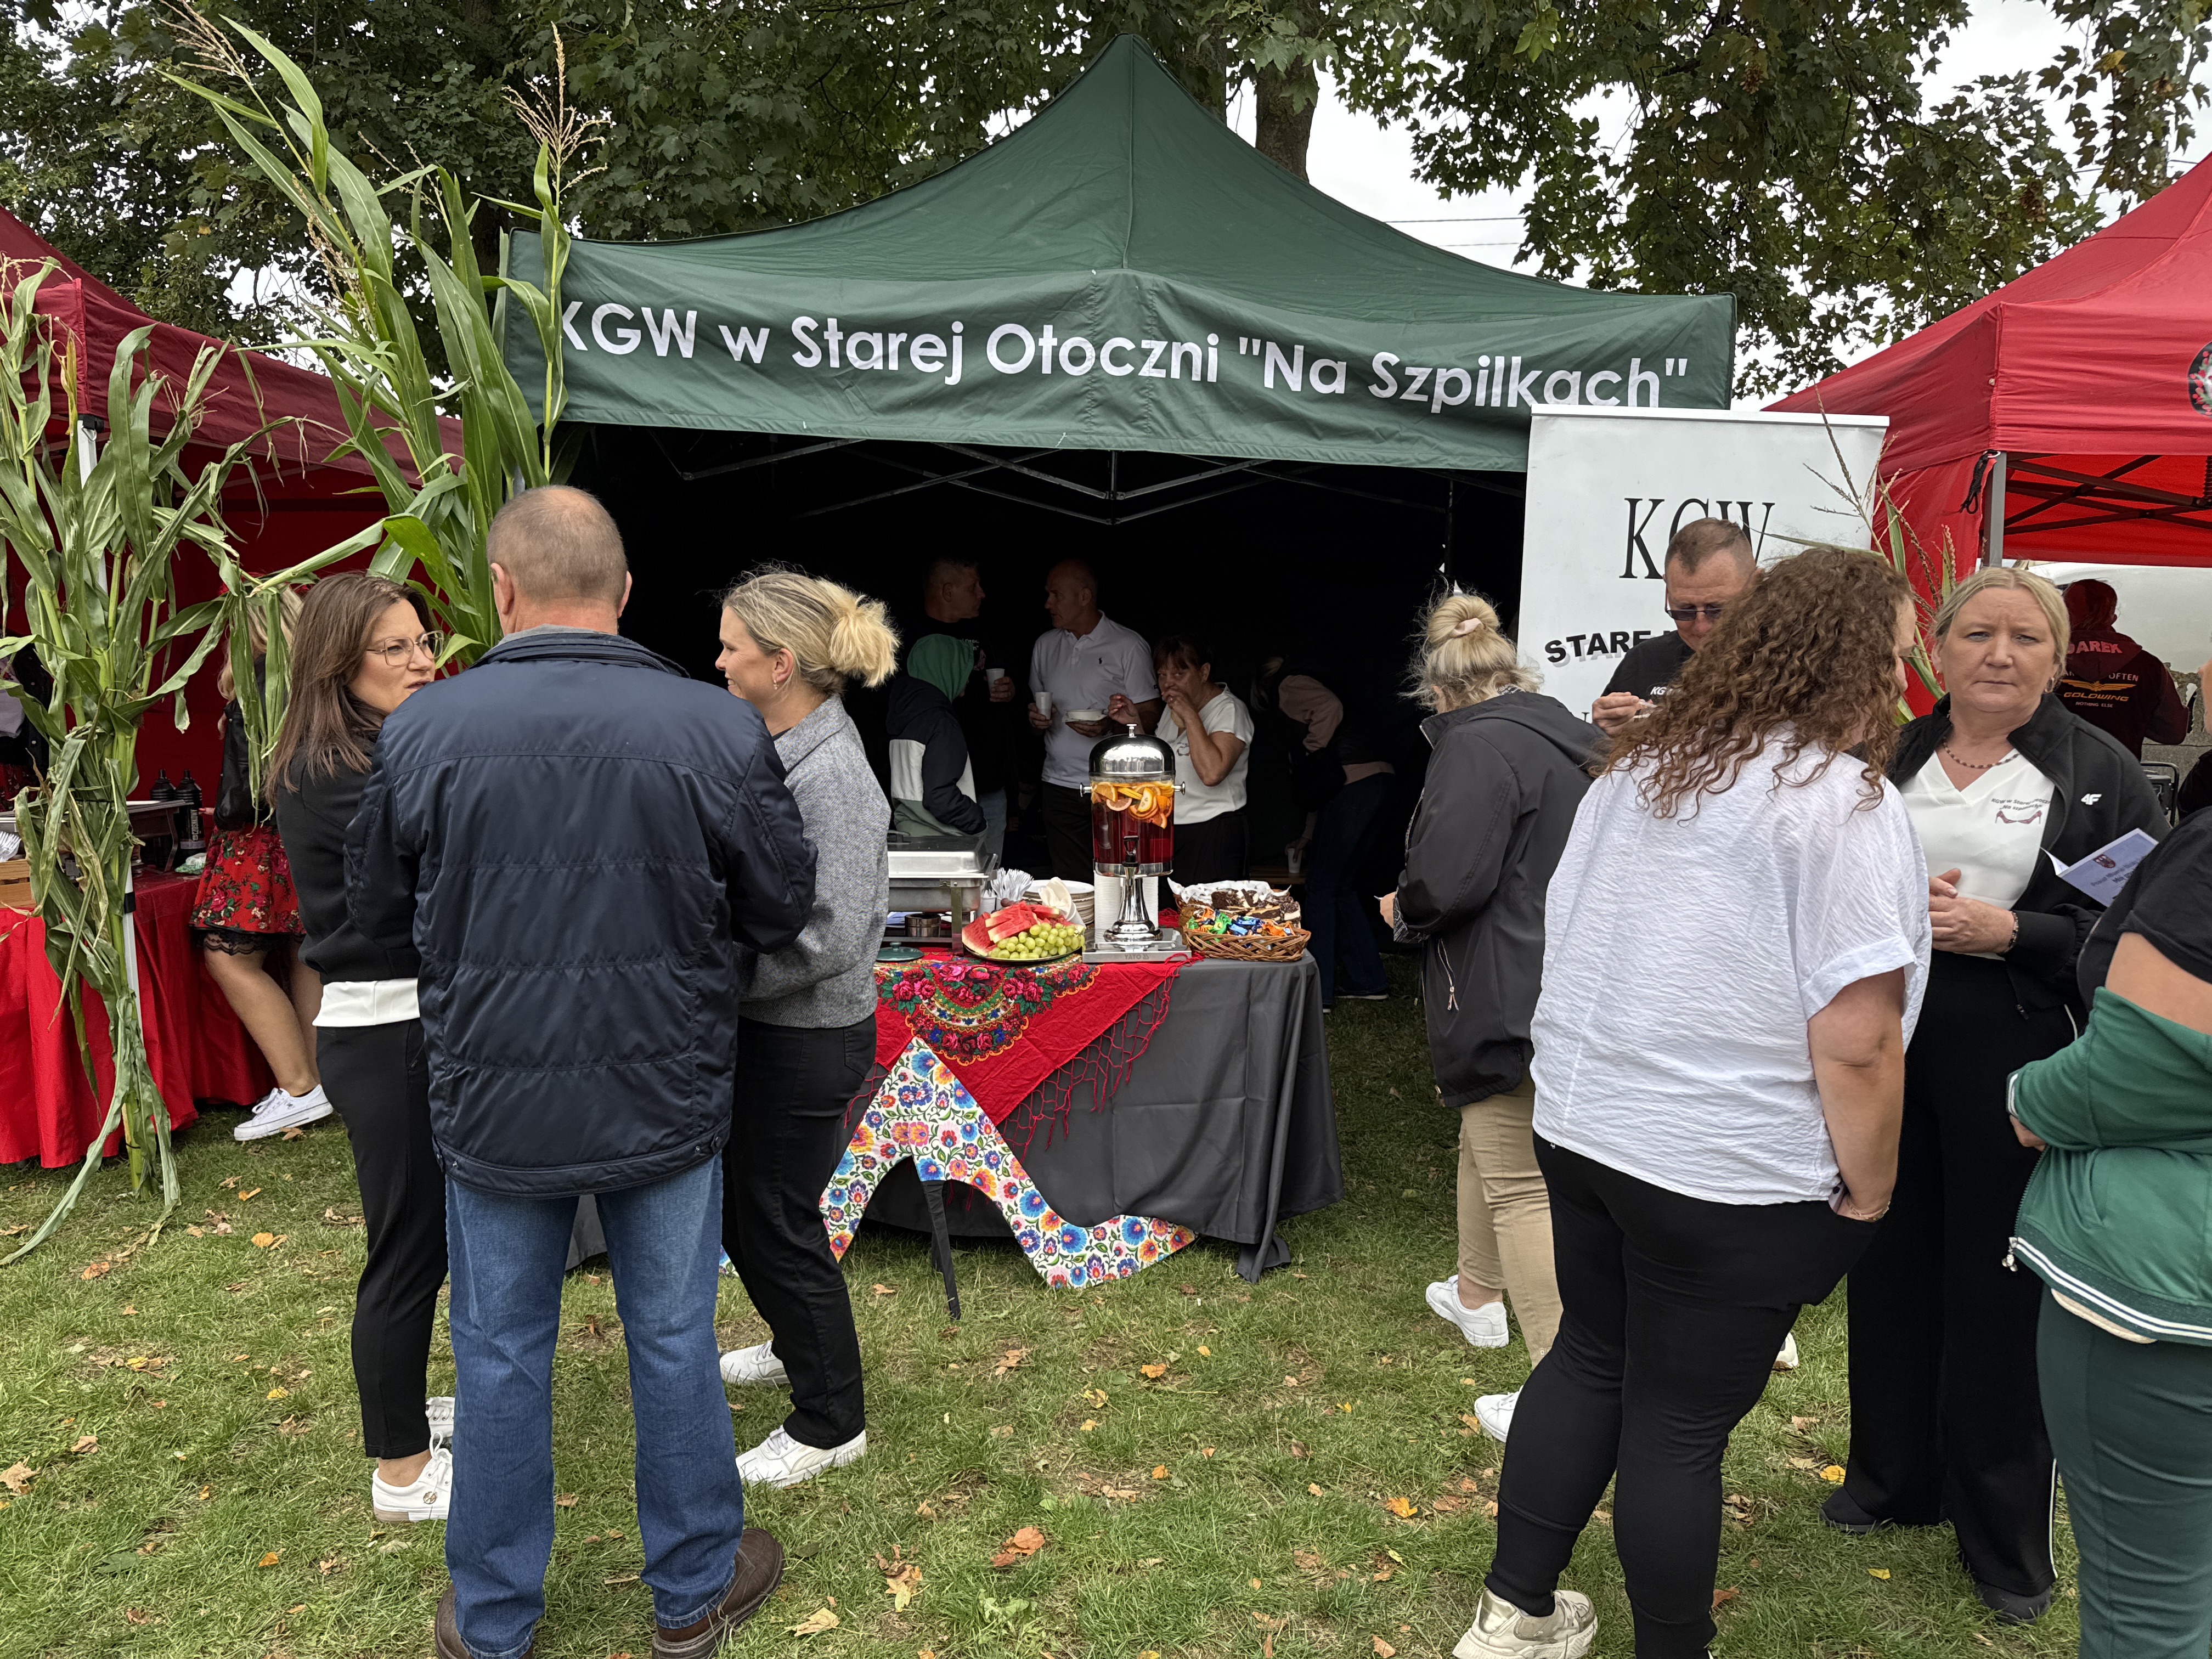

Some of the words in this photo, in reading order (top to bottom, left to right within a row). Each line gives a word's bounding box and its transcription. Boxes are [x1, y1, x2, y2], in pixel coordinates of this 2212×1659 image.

[562, 301, 698, 358] KGW
[718, 324, 770, 364] w
[791, 316, 964, 386] Starej
[986, 323, 1219, 382] Otoczni
[1239, 336, 1347, 394] "Na
[1368, 352, 1688, 414] Szpilkach"
[1650, 686, 1674, 696] KG
[2063, 692, 2129, 702] GOLDWING
[2081, 793, 2102, 805] 4F
